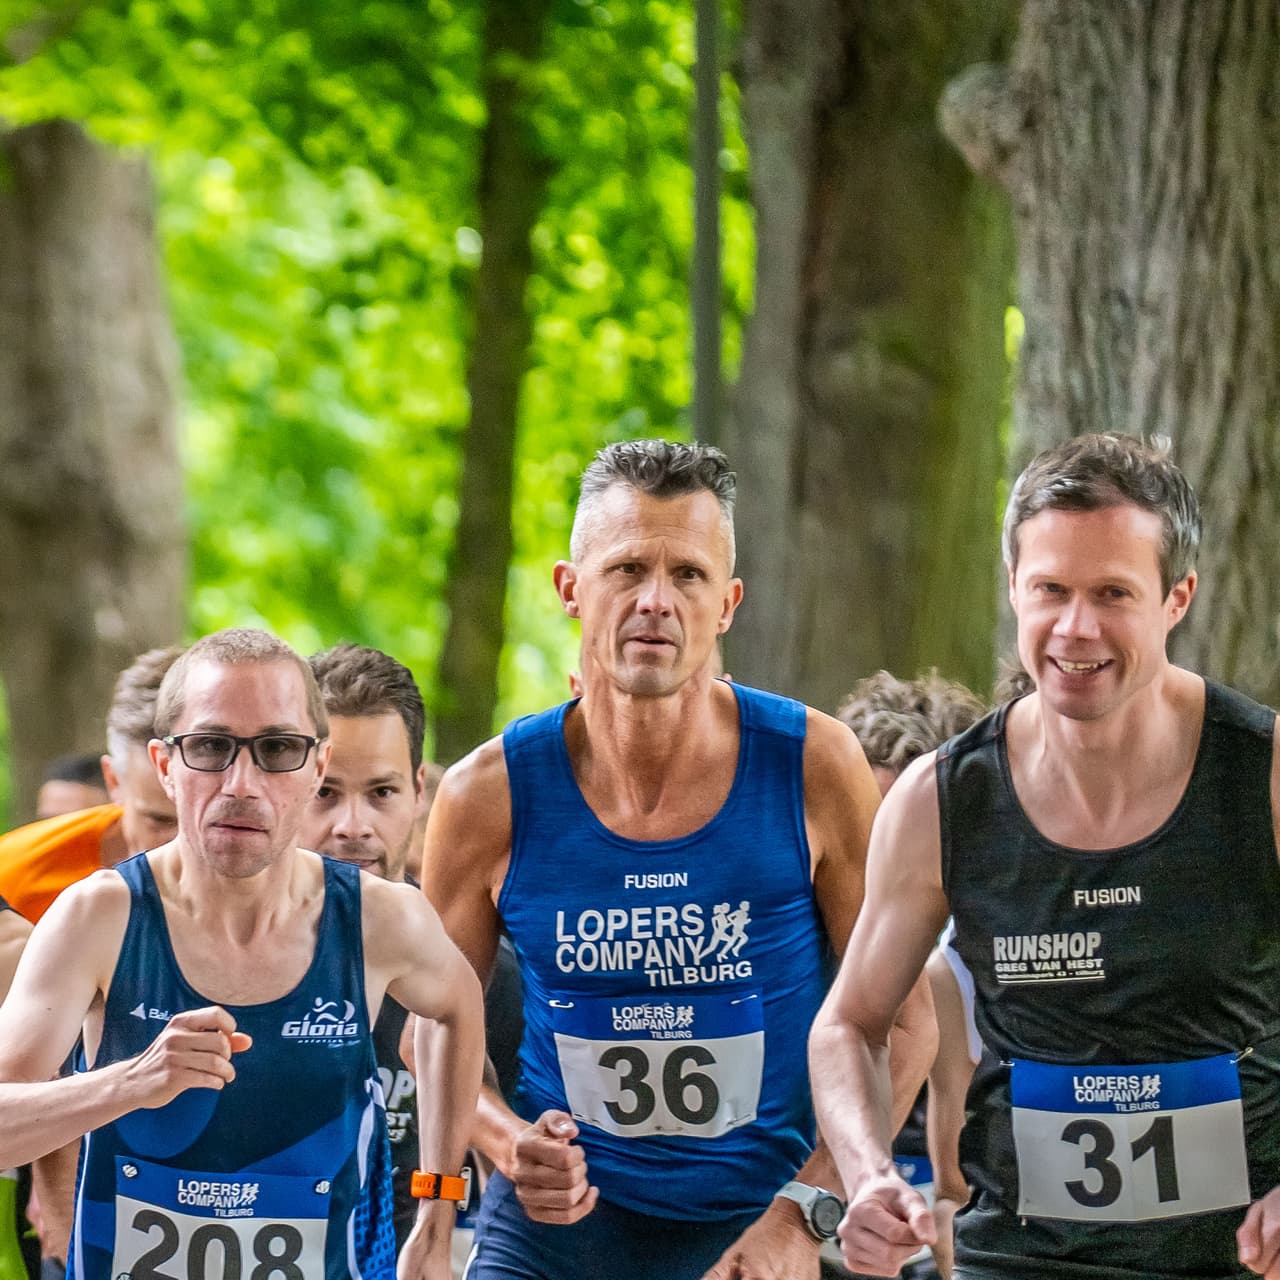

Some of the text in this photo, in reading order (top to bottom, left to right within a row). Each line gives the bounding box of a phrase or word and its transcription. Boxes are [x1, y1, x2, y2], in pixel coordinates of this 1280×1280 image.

[624, 872, 688, 889] FUSION
[1073, 886, 1141, 906] FUSION
[556, 903, 705, 942] LOPERS
[555, 935, 705, 973] COMPANY
[993, 932, 1101, 961] RUNSHOP
[995, 958, 1104, 972] GREG VAN HEST
[644, 960, 753, 987] TILBURG
[612, 1006, 674, 1020] LOPERS
[281, 1020, 358, 1036] Gloria
[613, 1018, 675, 1031] COMPANY
[650, 1030, 693, 1039] TILBURG
[598, 1045, 720, 1126] 36
[1073, 1076, 1140, 1090] LOPERS
[1075, 1088, 1141, 1102] COMPANY
[1114, 1101, 1160, 1112] TILBURG
[1061, 1116, 1180, 1208] 31
[178, 1179, 240, 1196] LOPERS
[178, 1193, 241, 1208] COMPANY
[214, 1208, 255, 1217] TILBURG
